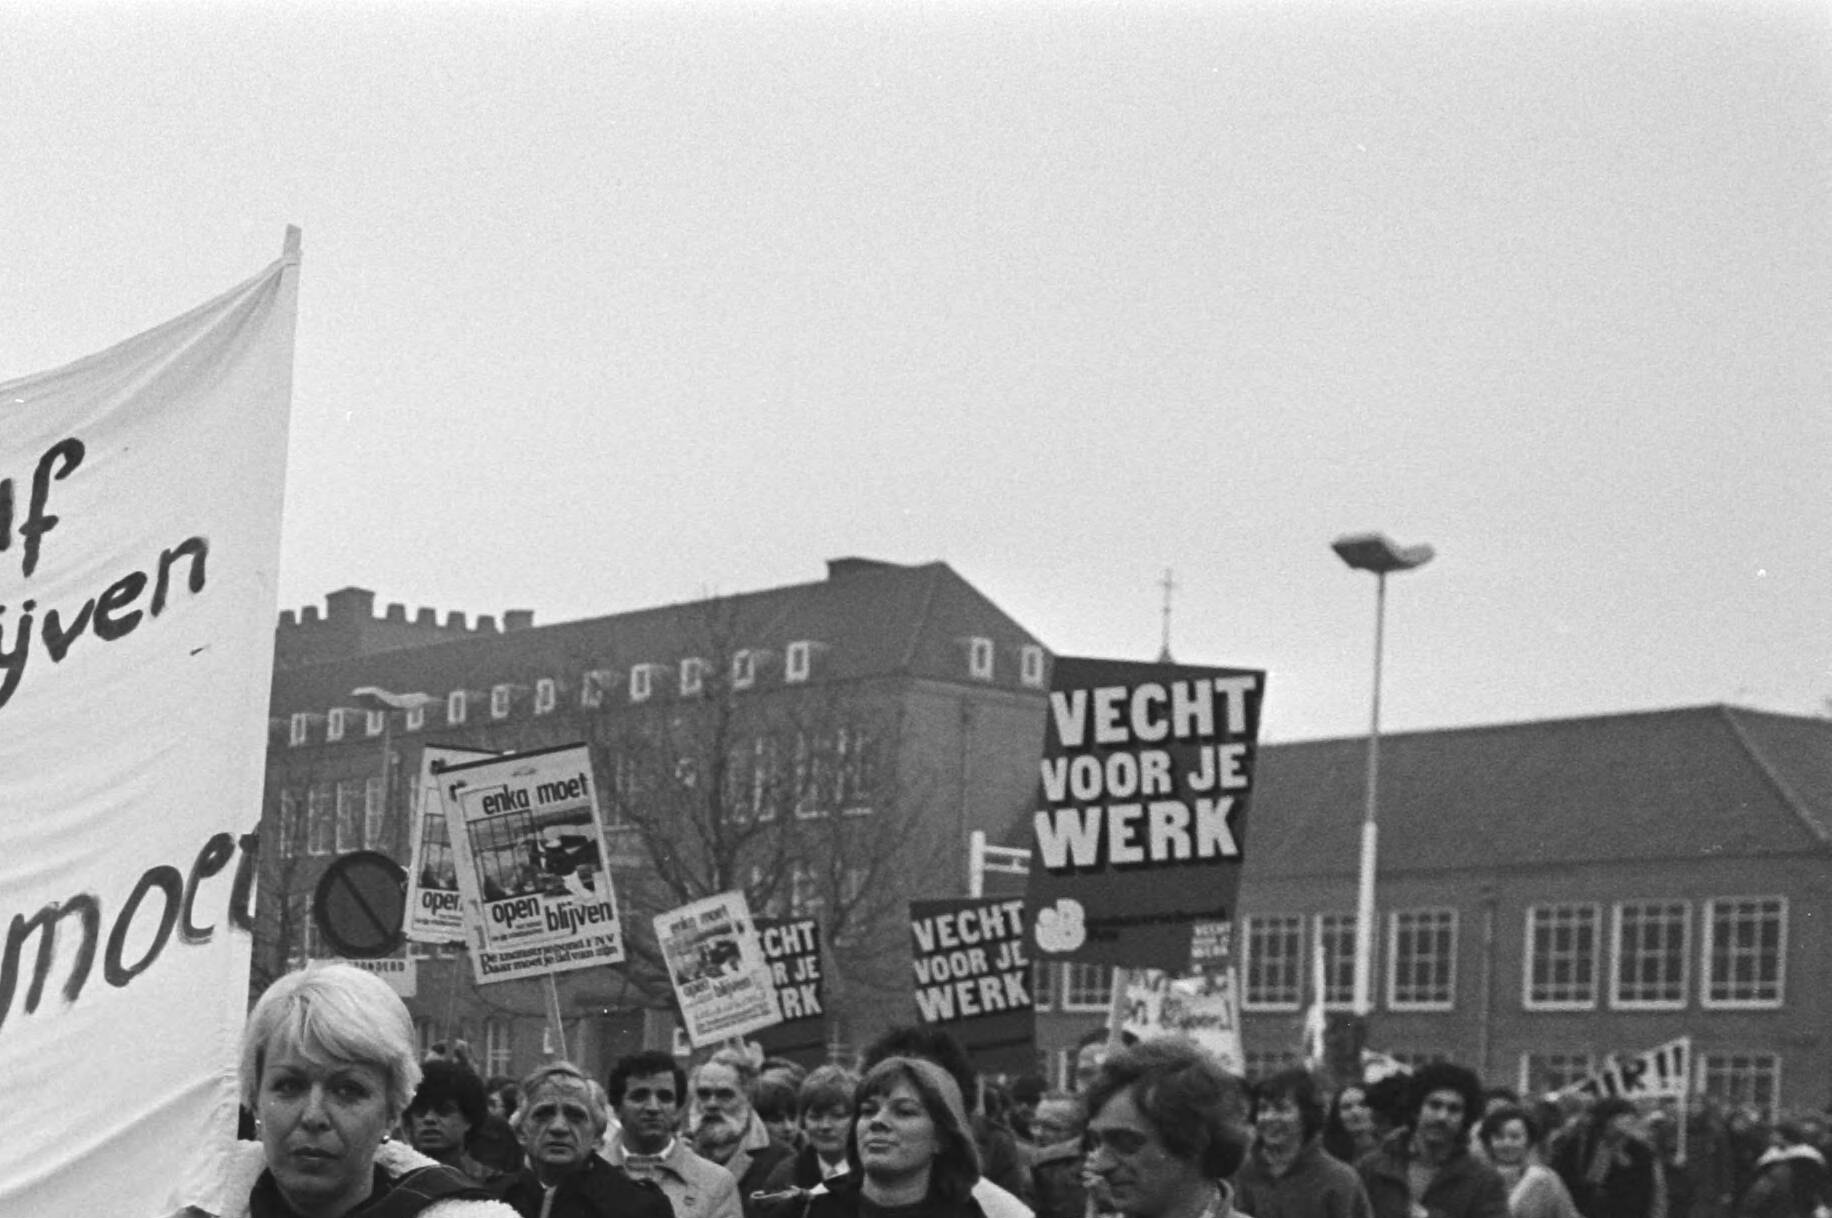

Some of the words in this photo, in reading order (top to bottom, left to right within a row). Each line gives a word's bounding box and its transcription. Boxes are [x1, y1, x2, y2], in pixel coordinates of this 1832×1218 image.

[1049, 675, 1256, 747] VECHT
[1040, 749, 1172, 802] VOOR
[1187, 743, 1249, 791] JE
[482, 784, 530, 816] enka
[536, 773, 589, 805] moet
[1033, 796, 1238, 869] WERK
[491, 897, 541, 930] open
[545, 901, 615, 935] blijven
[912, 900, 1024, 952] VECHT
[760, 921, 815, 958] CHT
[795, 956, 820, 981] JE
[914, 948, 988, 984] VOOR
[996, 941, 1029, 970] JE
[778, 984, 822, 1019] RK
[915, 971, 1030, 1022] WERK
